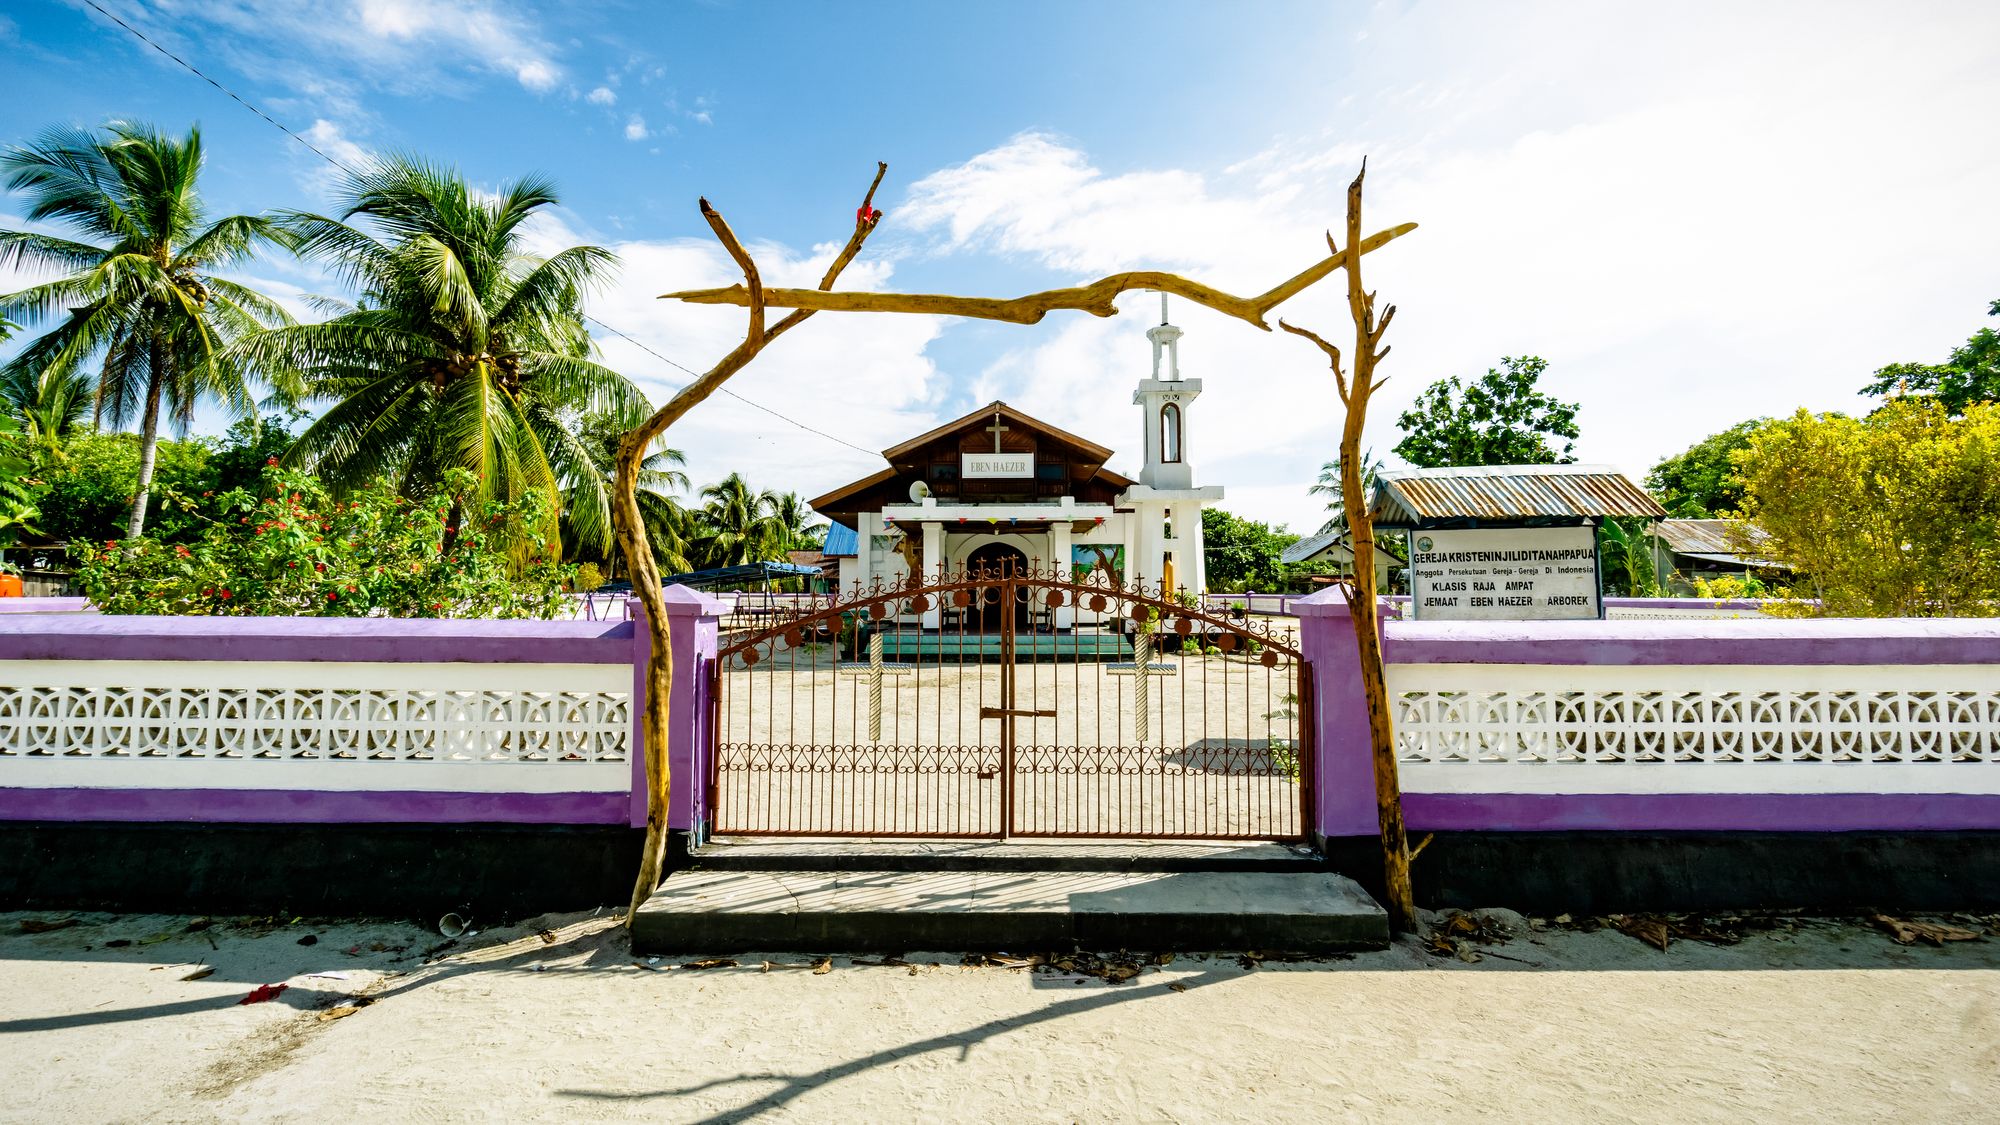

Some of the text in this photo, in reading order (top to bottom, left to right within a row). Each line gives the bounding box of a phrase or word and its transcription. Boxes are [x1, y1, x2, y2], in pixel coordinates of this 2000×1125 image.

[970, 462, 1025, 472] EBEN HAEZER
[1416, 569, 1443, 578] Anggota
[1432, 581, 1534, 591] KLASIS RAJA AMPAT
[1424, 596, 1588, 606] JEMAAT EBEN HAEZER ARBOREK
